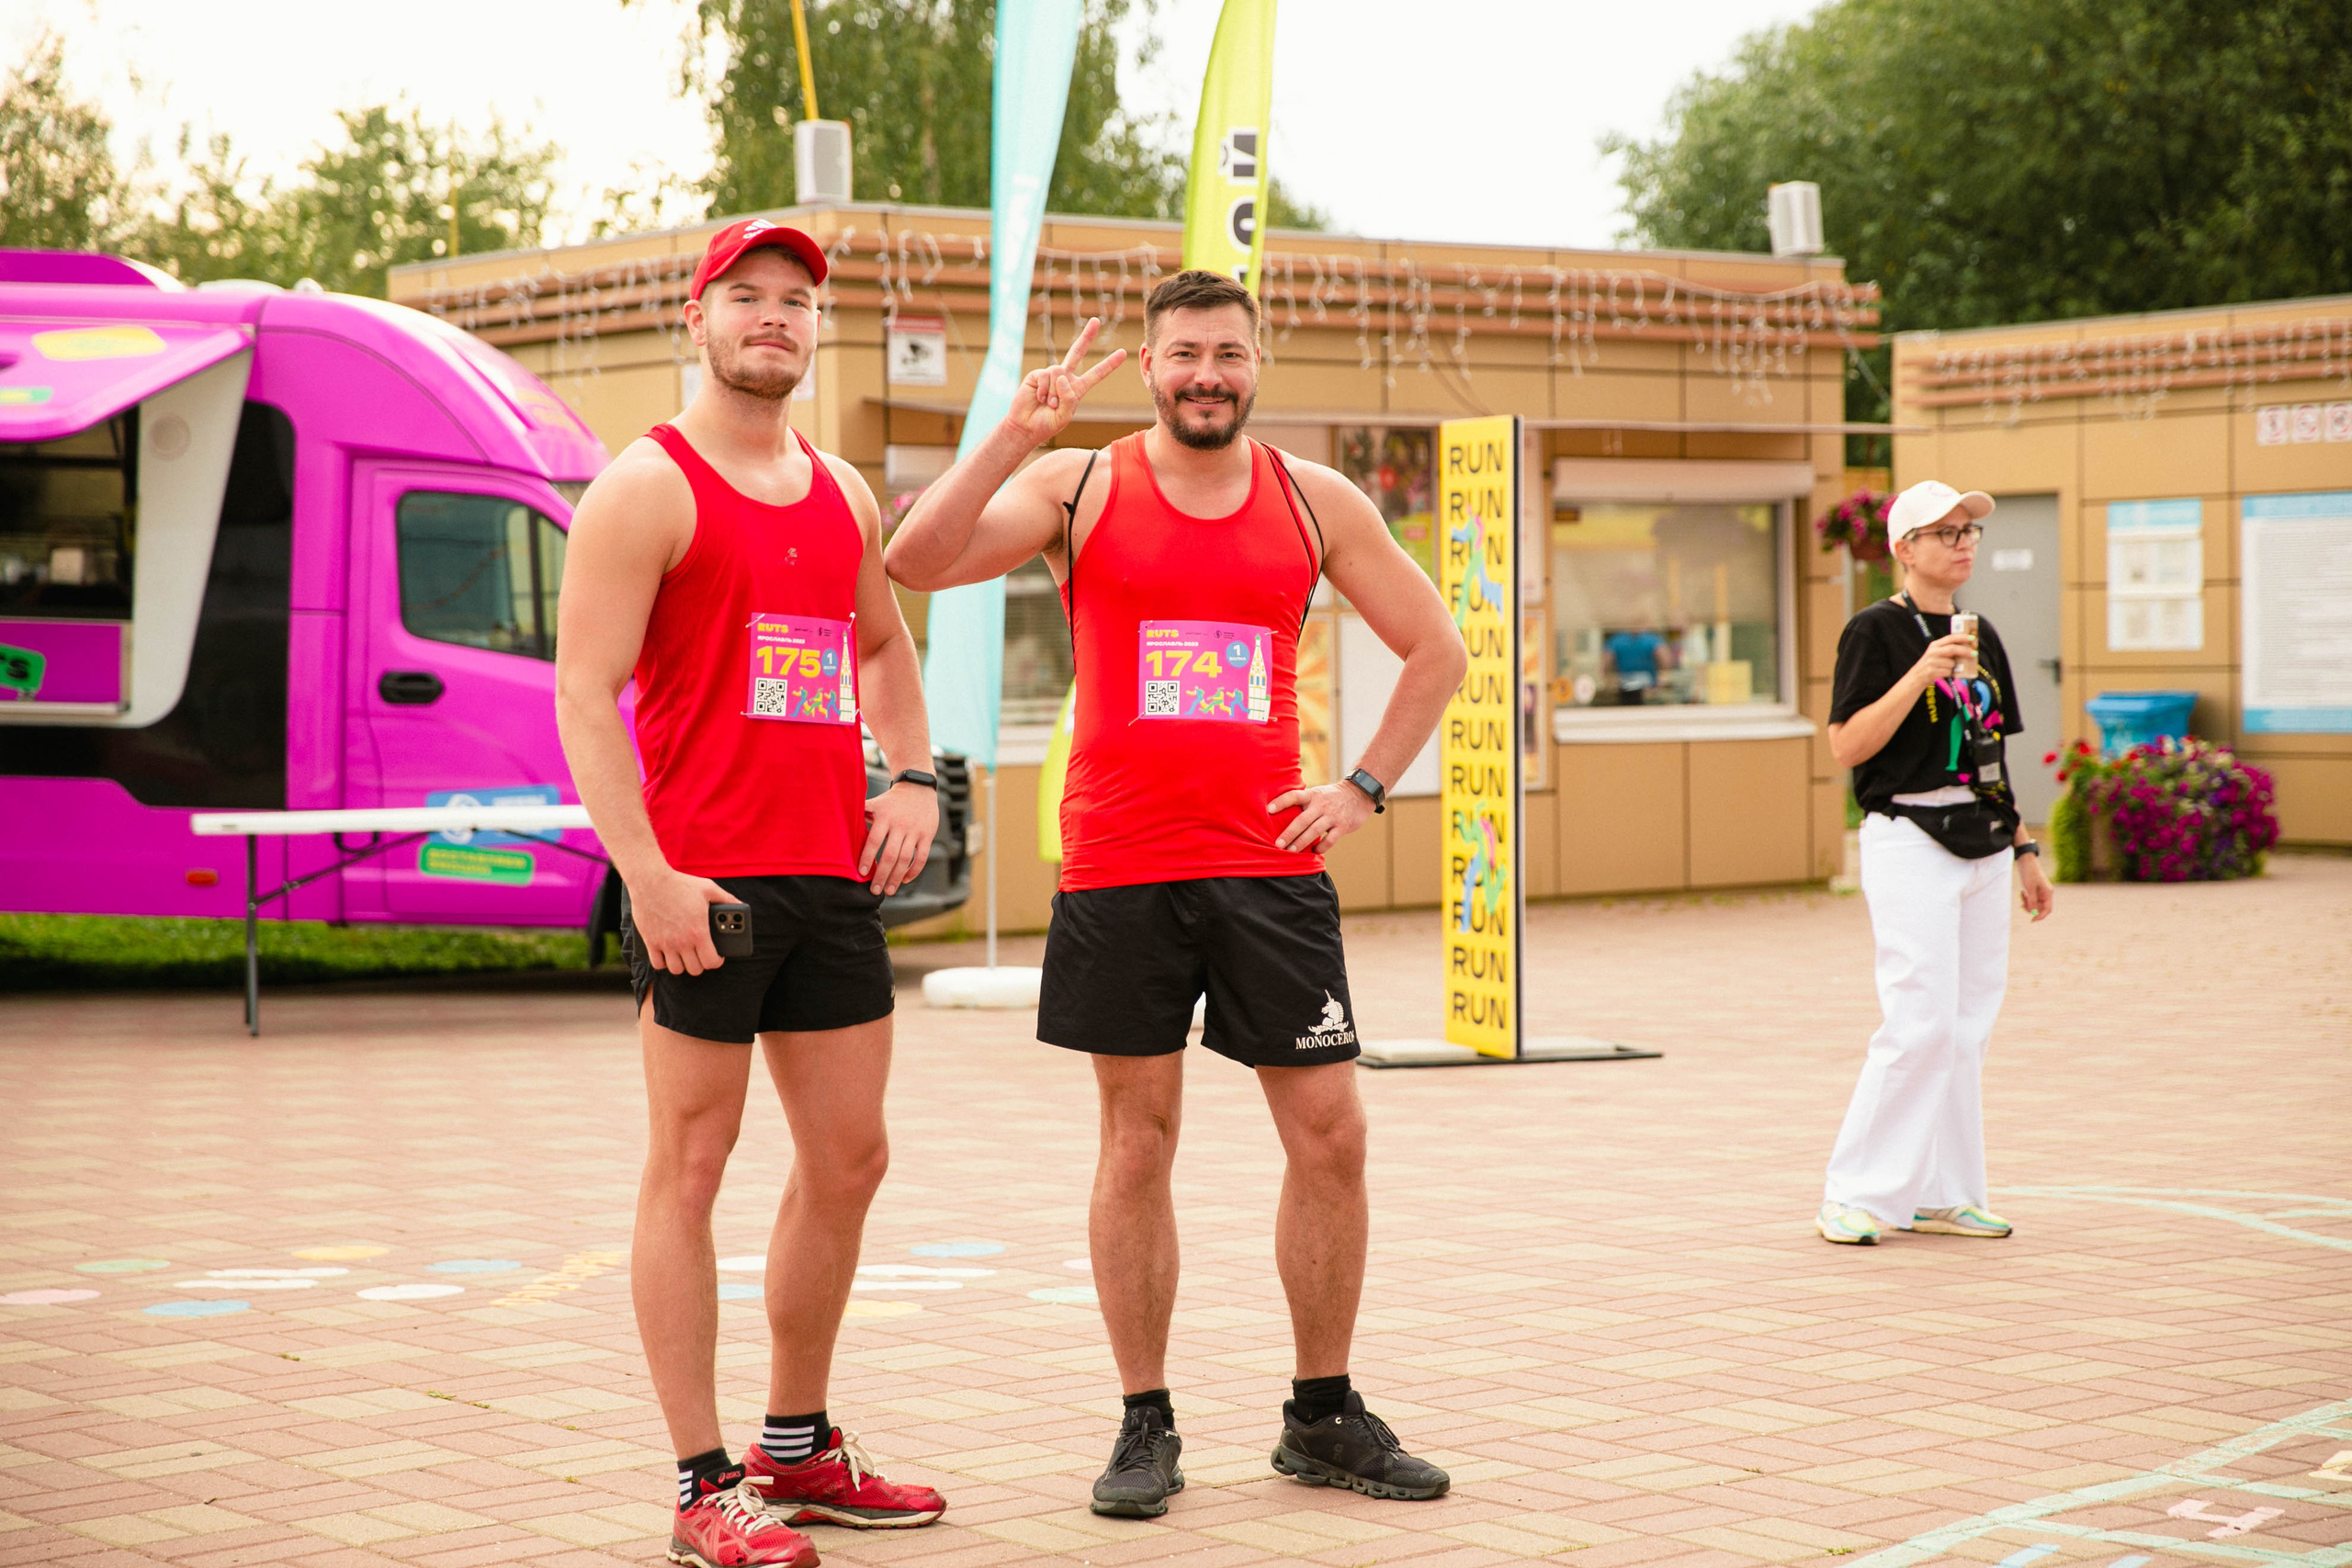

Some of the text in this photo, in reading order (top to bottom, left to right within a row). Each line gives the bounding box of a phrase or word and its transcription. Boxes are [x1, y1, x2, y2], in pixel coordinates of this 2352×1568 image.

[1450, 441, 1504, 474] RUN
[1450, 534, 1504, 567] RN
[758, 623, 789, 633] RUTS
[1146, 629, 1179, 638] RUTS
[1463, 626, 1504, 658] UN
[756, 646, 820, 678] 175
[827, 652, 833, 665] 1
[1146, 650, 1222, 678] 174
[1233, 645, 1241, 656] 1
[1451, 718, 1504, 751] RUN
[1451, 765, 1504, 797] RUN
[1453, 946, 1505, 983] RUN
[1453, 991, 1505, 1029] RUN
